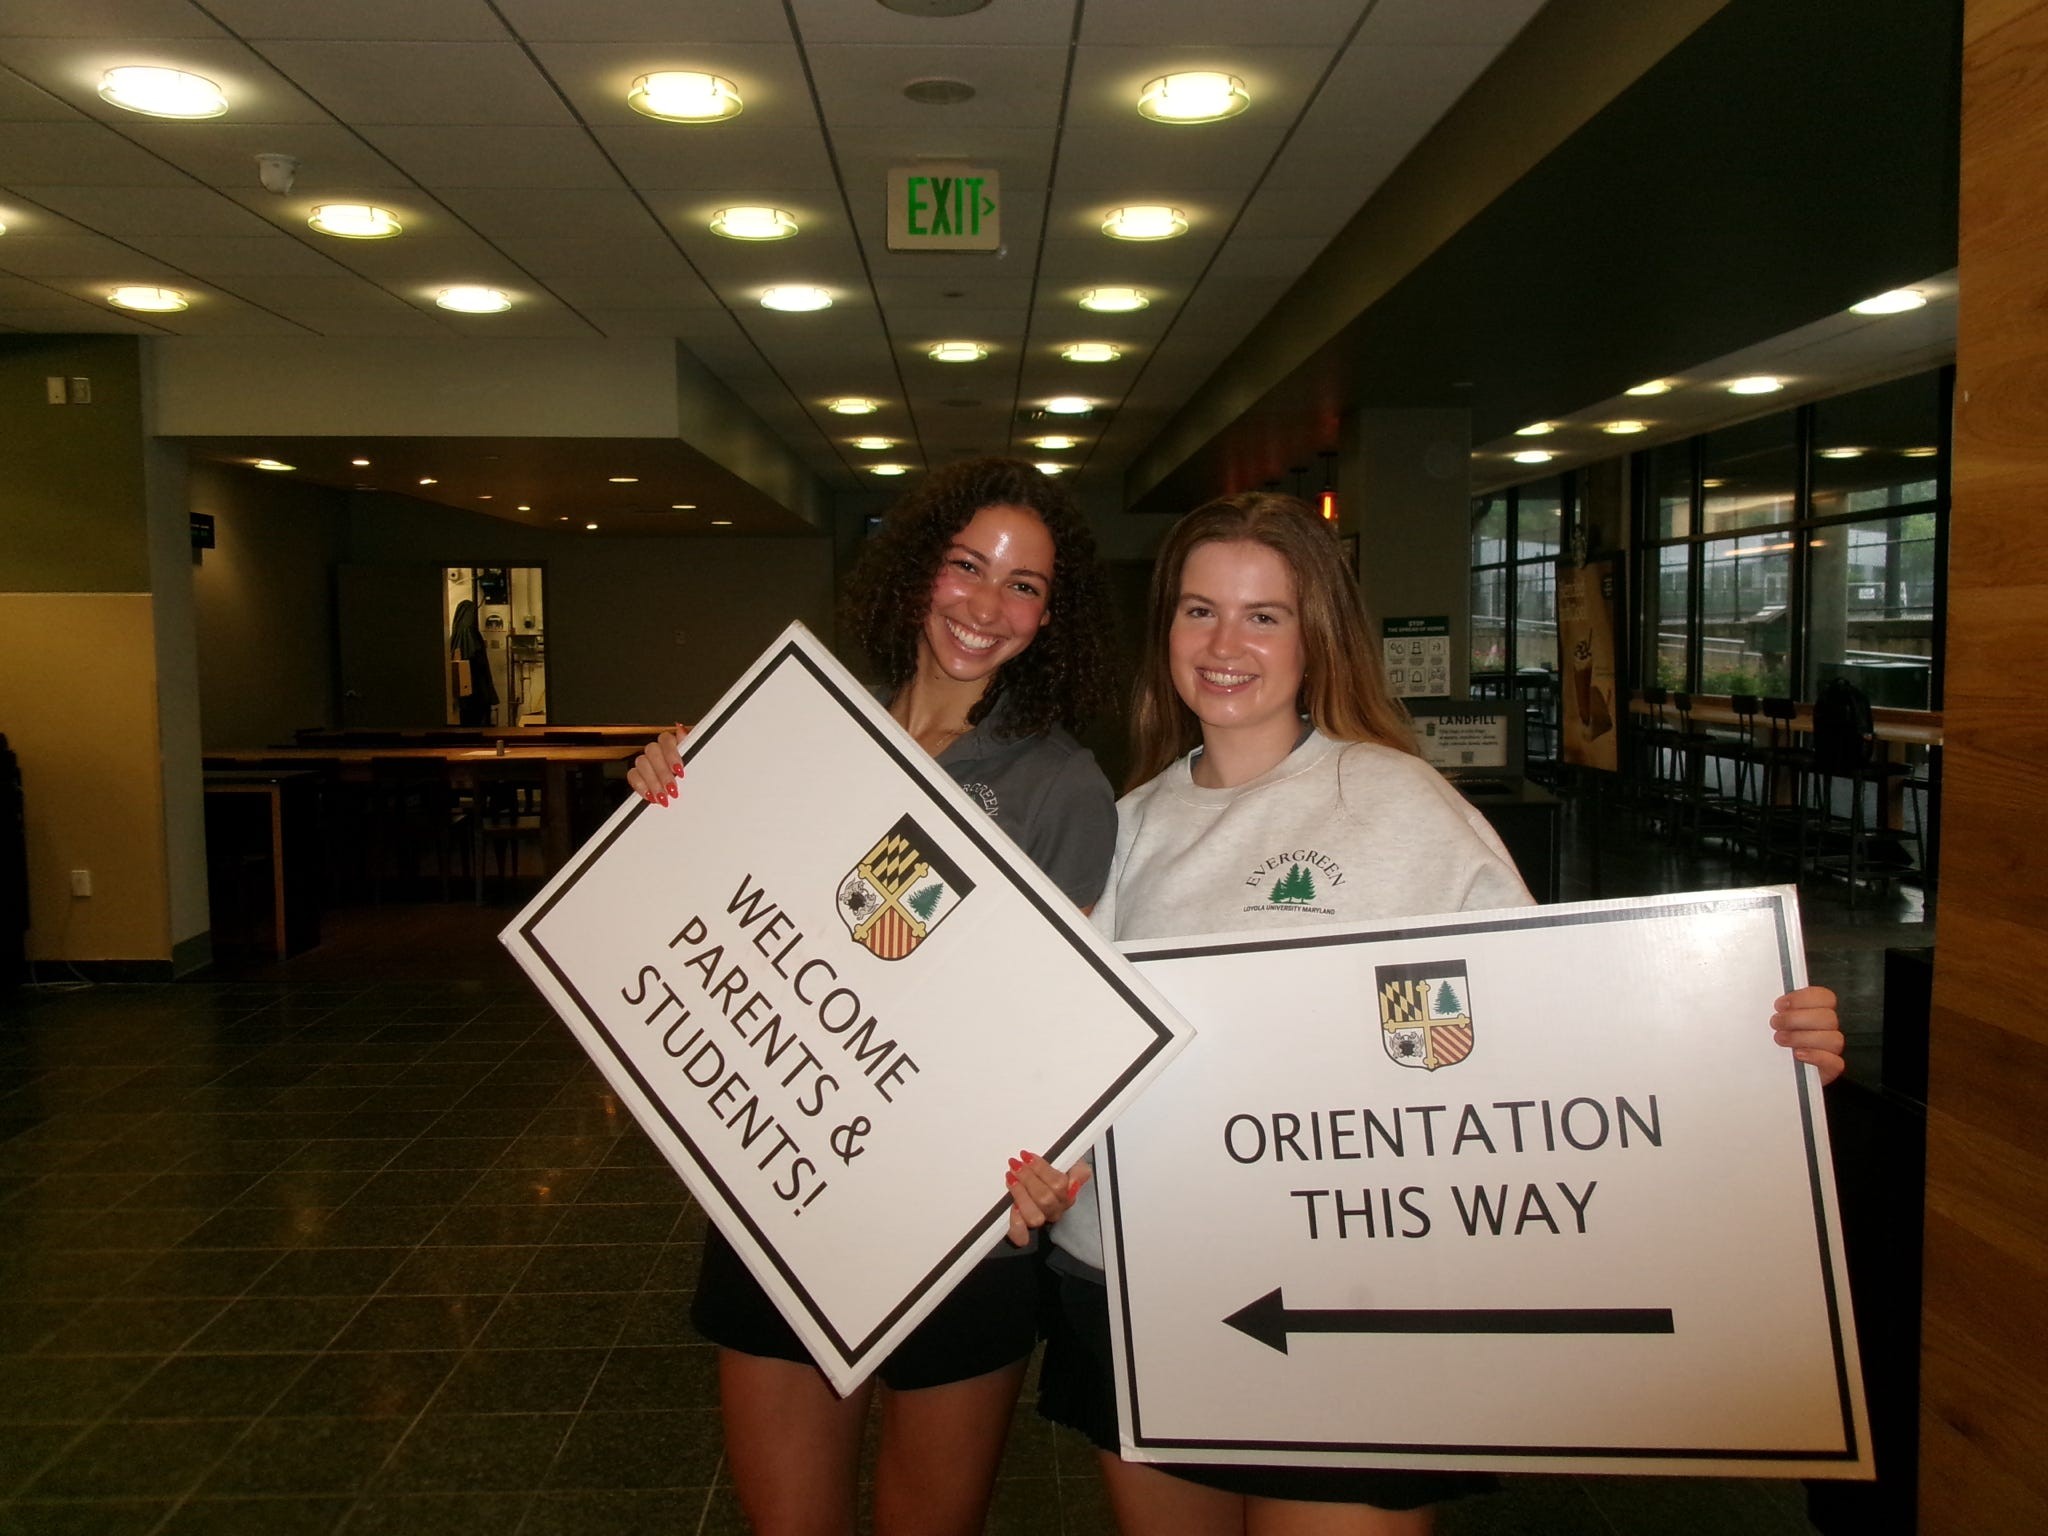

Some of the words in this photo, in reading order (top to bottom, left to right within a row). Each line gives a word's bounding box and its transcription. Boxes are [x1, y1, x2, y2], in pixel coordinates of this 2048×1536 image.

[908, 177, 985, 236] EXIT
[1439, 714, 1497, 725] LANDFILL
[1246, 849, 1346, 887] EVERGREEN
[1243, 904, 1265, 913] LOYOLA
[1266, 904, 1301, 912] UNIVERSITY
[1302, 905, 1336, 915] MARYLAND
[726, 873, 920, 1103] WELCOME
[668, 915, 840, 1117] PARENTS
[830, 1115, 871, 1167] &
[621, 965, 828, 1217] STUDENTS!
[1224, 1094, 1662, 1165] ORIENTATION
[1290, 1185, 1432, 1240] THIS
[1450, 1180, 1597, 1237] WAY
